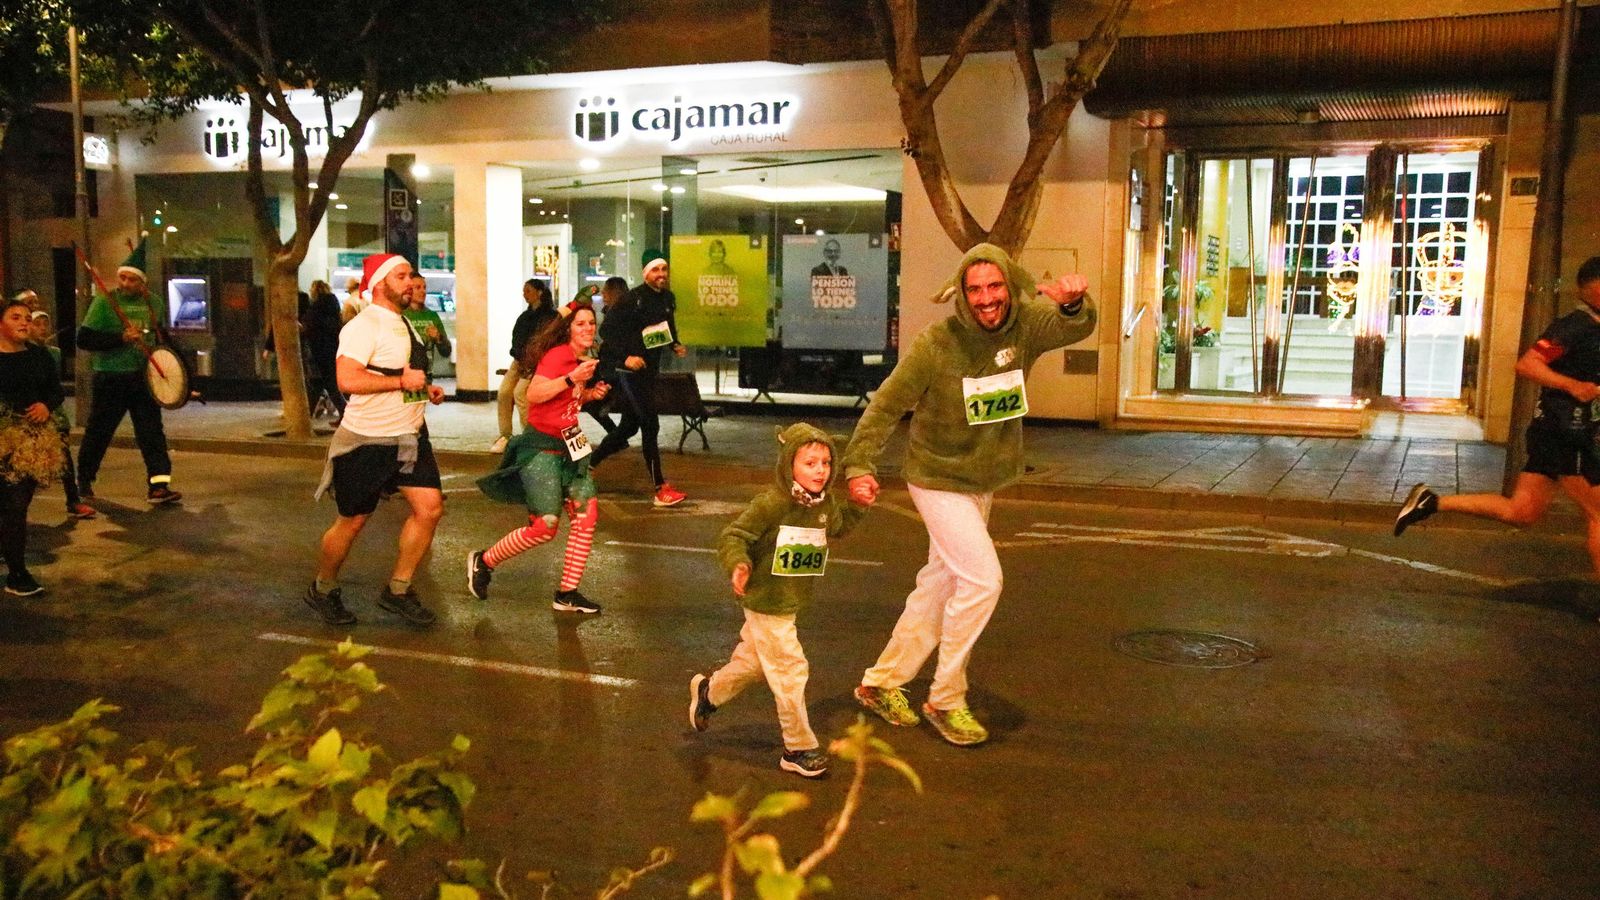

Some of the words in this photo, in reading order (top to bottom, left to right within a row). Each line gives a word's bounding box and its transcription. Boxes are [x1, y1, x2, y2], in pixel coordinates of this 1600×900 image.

[632, 95, 790, 141] cajamar
[698, 294, 739, 306] TODO
[812, 295, 857, 308] TODO
[969, 394, 1022, 417] 1742
[779, 551, 823, 569] 1849
